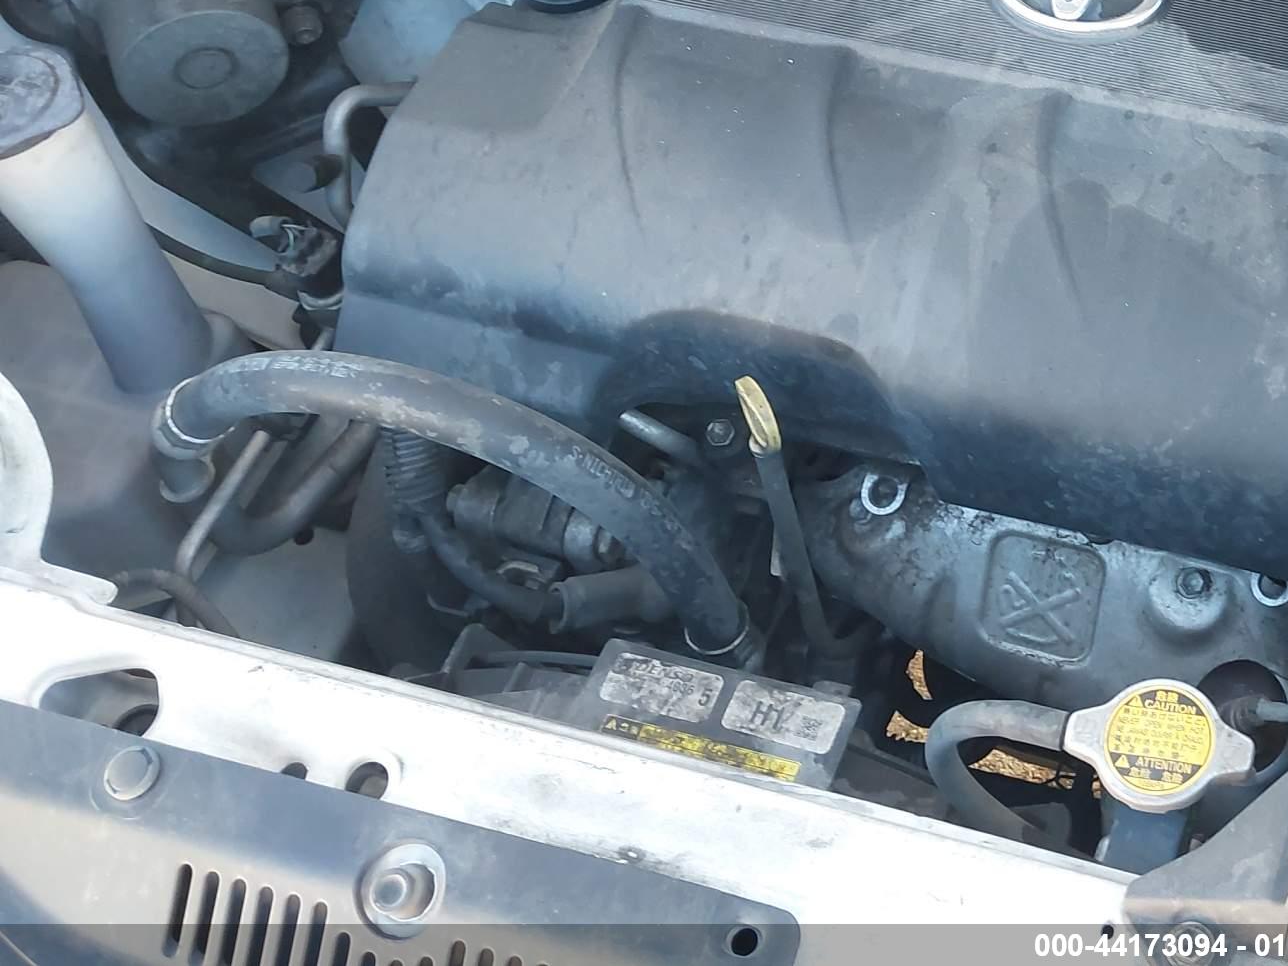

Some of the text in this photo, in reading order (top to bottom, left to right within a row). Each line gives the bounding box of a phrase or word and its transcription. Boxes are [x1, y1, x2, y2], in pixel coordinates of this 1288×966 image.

[698, 688, 713, 707] 5
[1144, 699, 1197, 715] CAUTION
[1135, 756, 1192, 774] ATTENTION
